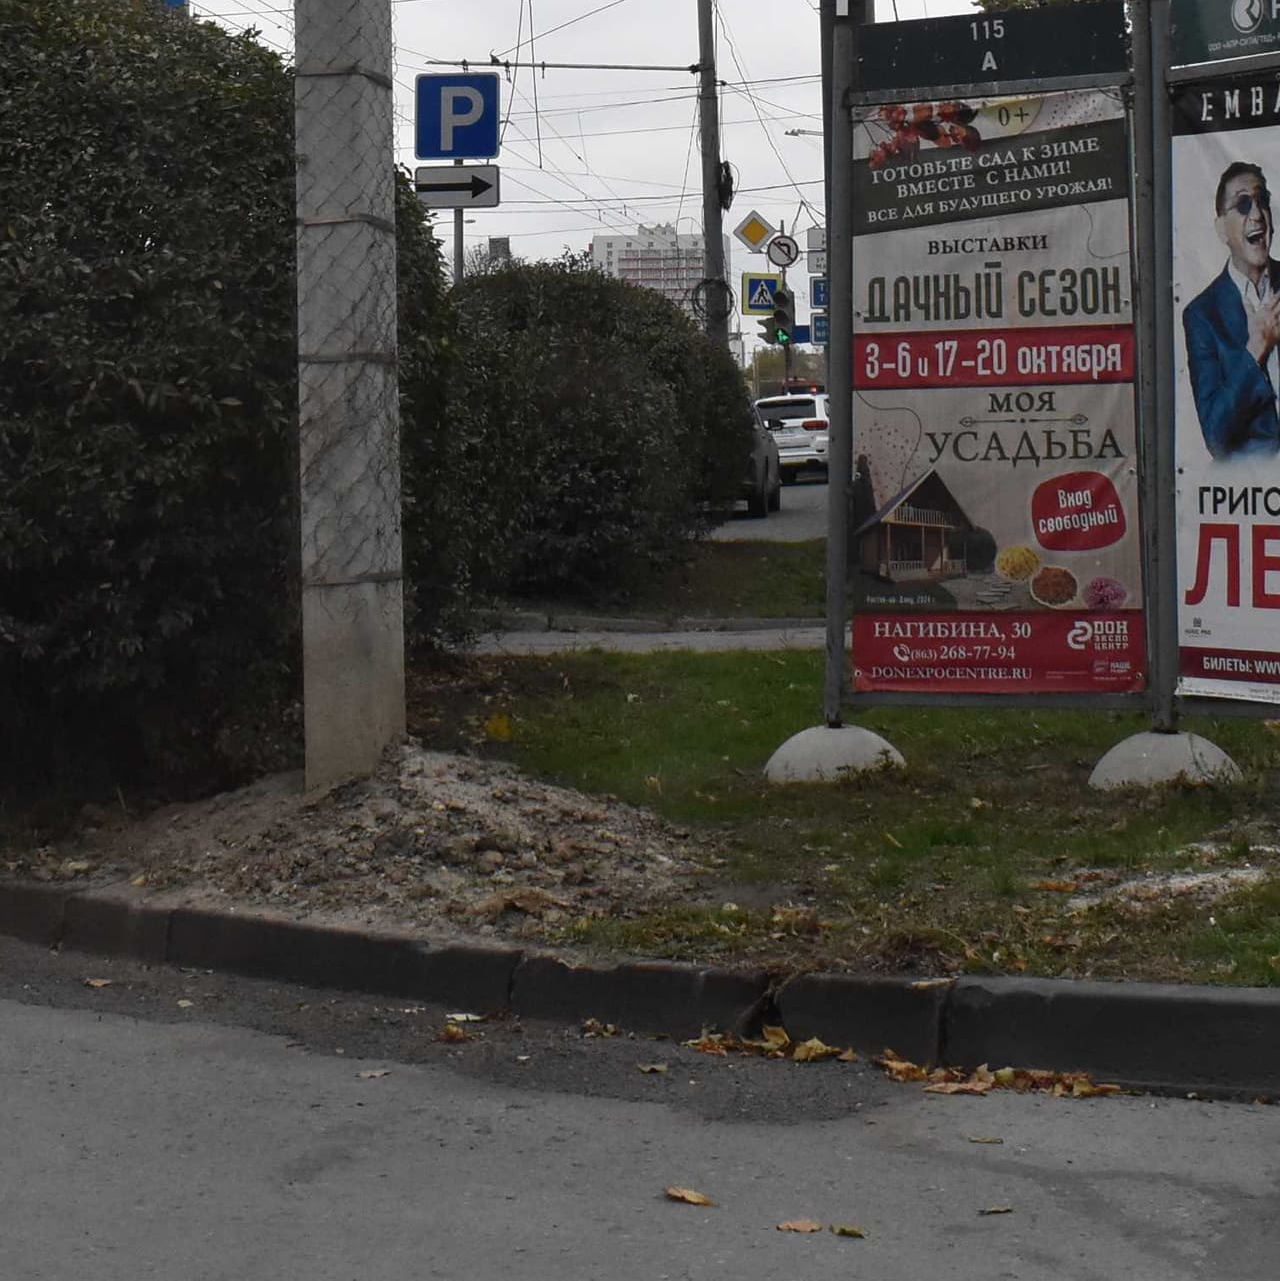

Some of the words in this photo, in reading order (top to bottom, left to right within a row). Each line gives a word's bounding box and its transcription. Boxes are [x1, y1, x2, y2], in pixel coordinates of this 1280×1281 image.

[969, 19, 1005, 41] 115
[440, 86, 484, 151] P
[997, 105, 1030, 127] 0+
[871, 156, 973, 184] ГОТОВЬТЕ
[978, 151, 1017, 168] САД
[1023, 146, 1036, 161] К
[1041, 137, 1100, 159] ЗИМЕ
[897, 174, 976, 199] ВМЕСТЕ
[986, 170, 999, 186] С
[1004, 160, 1071, 183] НАМИ!
[867, 207, 898, 223] ВСЕ
[902, 203, 935, 220] ДЛЯ
[938, 189, 1032, 214] БУДУЩЕГО
[1036, 177, 1113, 200] УРОЖАЯ!
[927, 234, 1049, 255] ВЫСТАВКИ
[863, 261, 1003, 323] ДАЧНЫЙ
[1017, 266, 1121, 318] СЕЗОН
[865, 341, 911, 379] 3-6
[917, 356, 929, 377] и
[1016, 343, 1122, 380] октября
[987, 390, 1057, 414] МОЯ
[923, 427, 1127, 468] УСАДЬБА
[1056, 489, 1092, 509] Вход
[1038, 504, 1119, 534] свободный
[873, 622, 1006, 640] НАГИБИНА,
[1011, 622, 1032, 639] 30
[1093, 621, 1129, 634] ДОН
[910, 648, 938, 661] (863)
[940, 645, 1016, 660] 268-77-94
[871, 666, 1033, 681] DONEXPOCENTRE.RU
[1203, 656, 1253, 674] БИЛЕТЫ:
